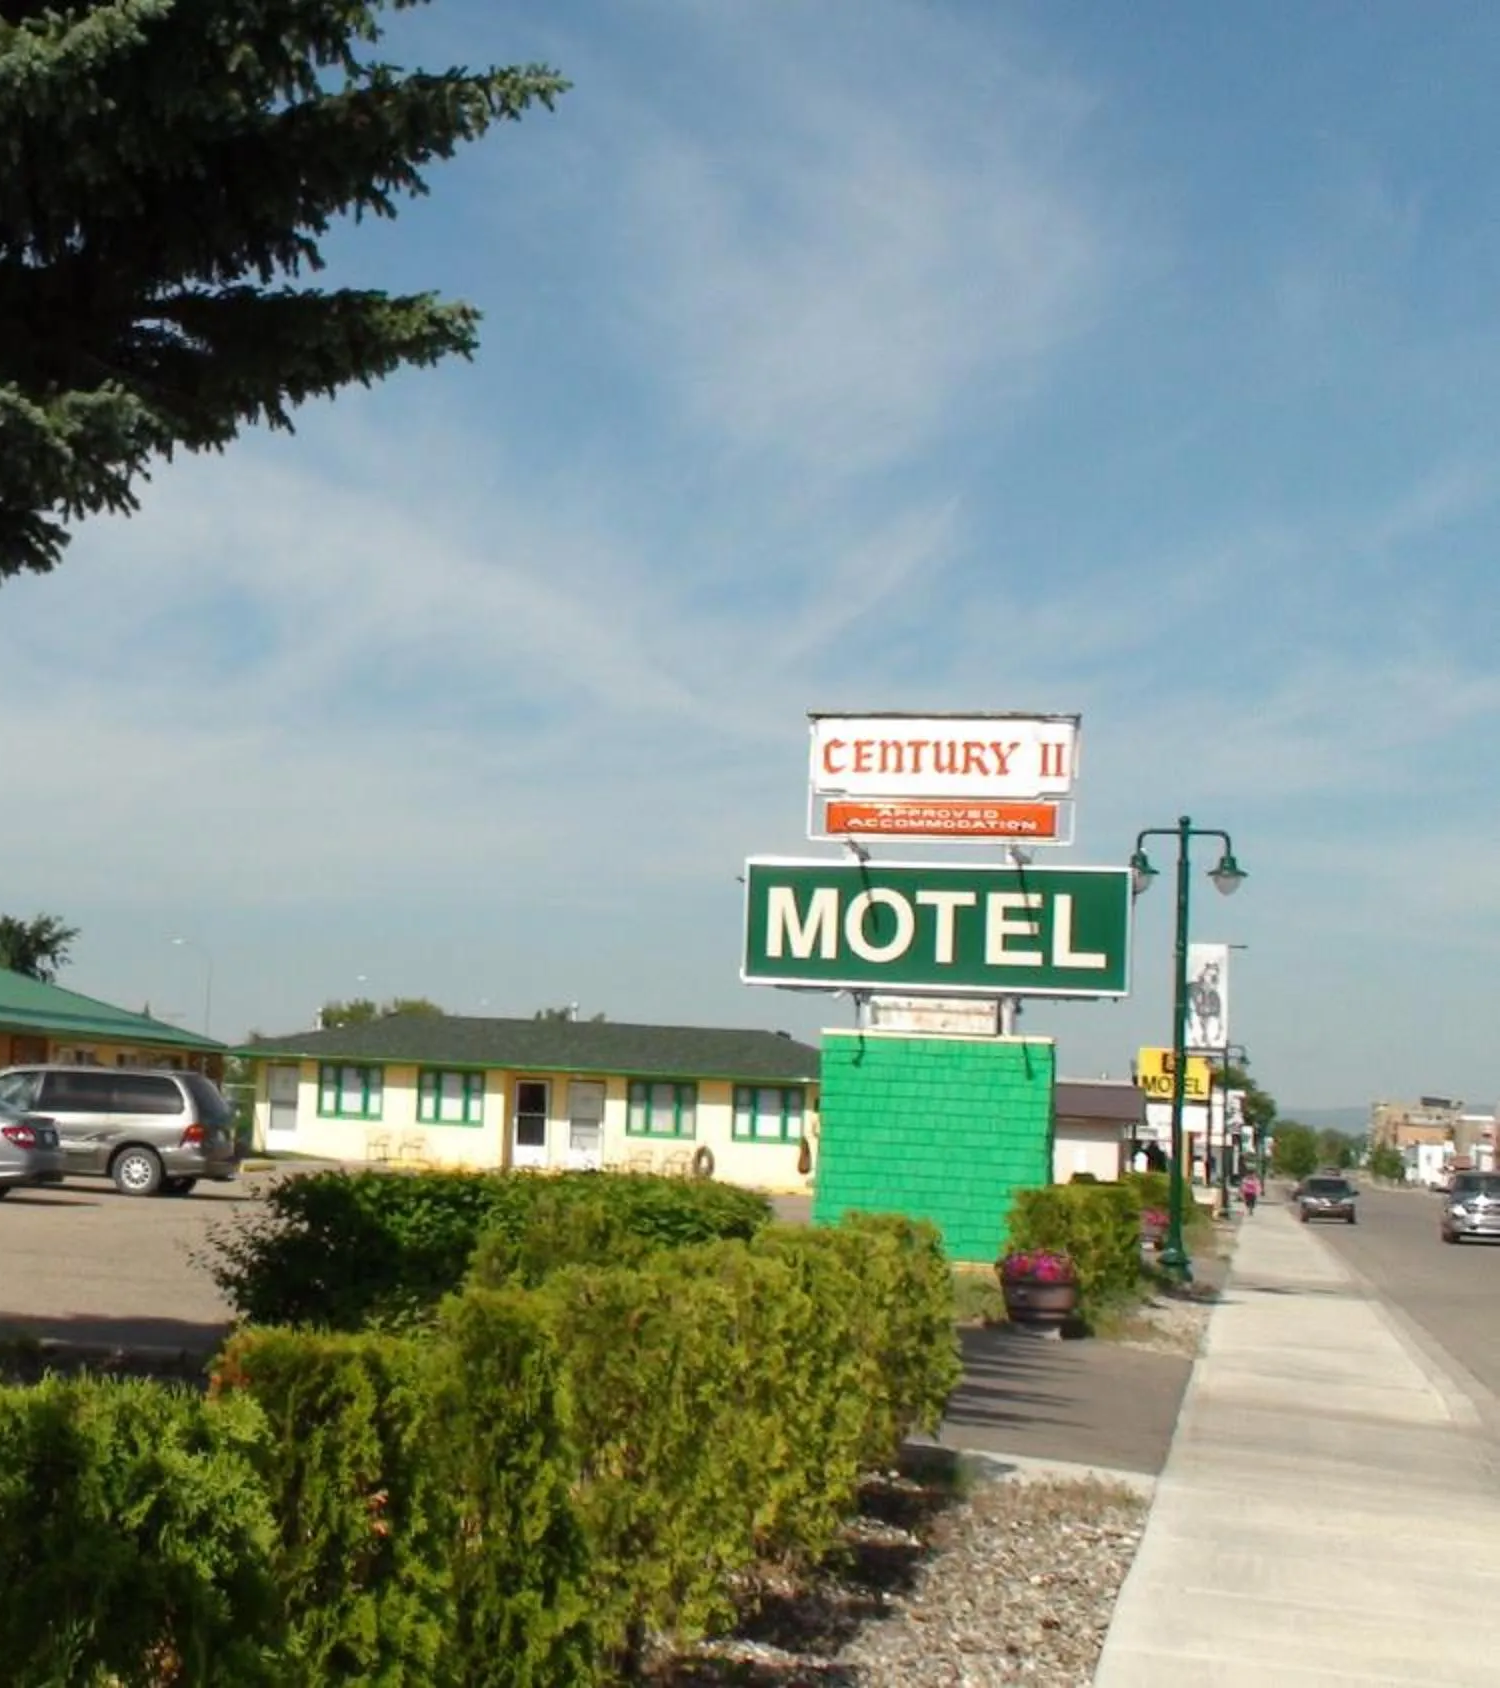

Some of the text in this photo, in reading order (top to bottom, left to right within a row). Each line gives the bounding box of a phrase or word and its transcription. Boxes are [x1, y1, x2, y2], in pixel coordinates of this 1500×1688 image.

[1039, 742, 1067, 777] II
[876, 808, 1001, 820] APPROVED
[847, 817, 1038, 832] ACCOMMODATION
[765, 886, 1107, 969] MOTEL
[1142, 1075, 1205, 1095] MOEL
